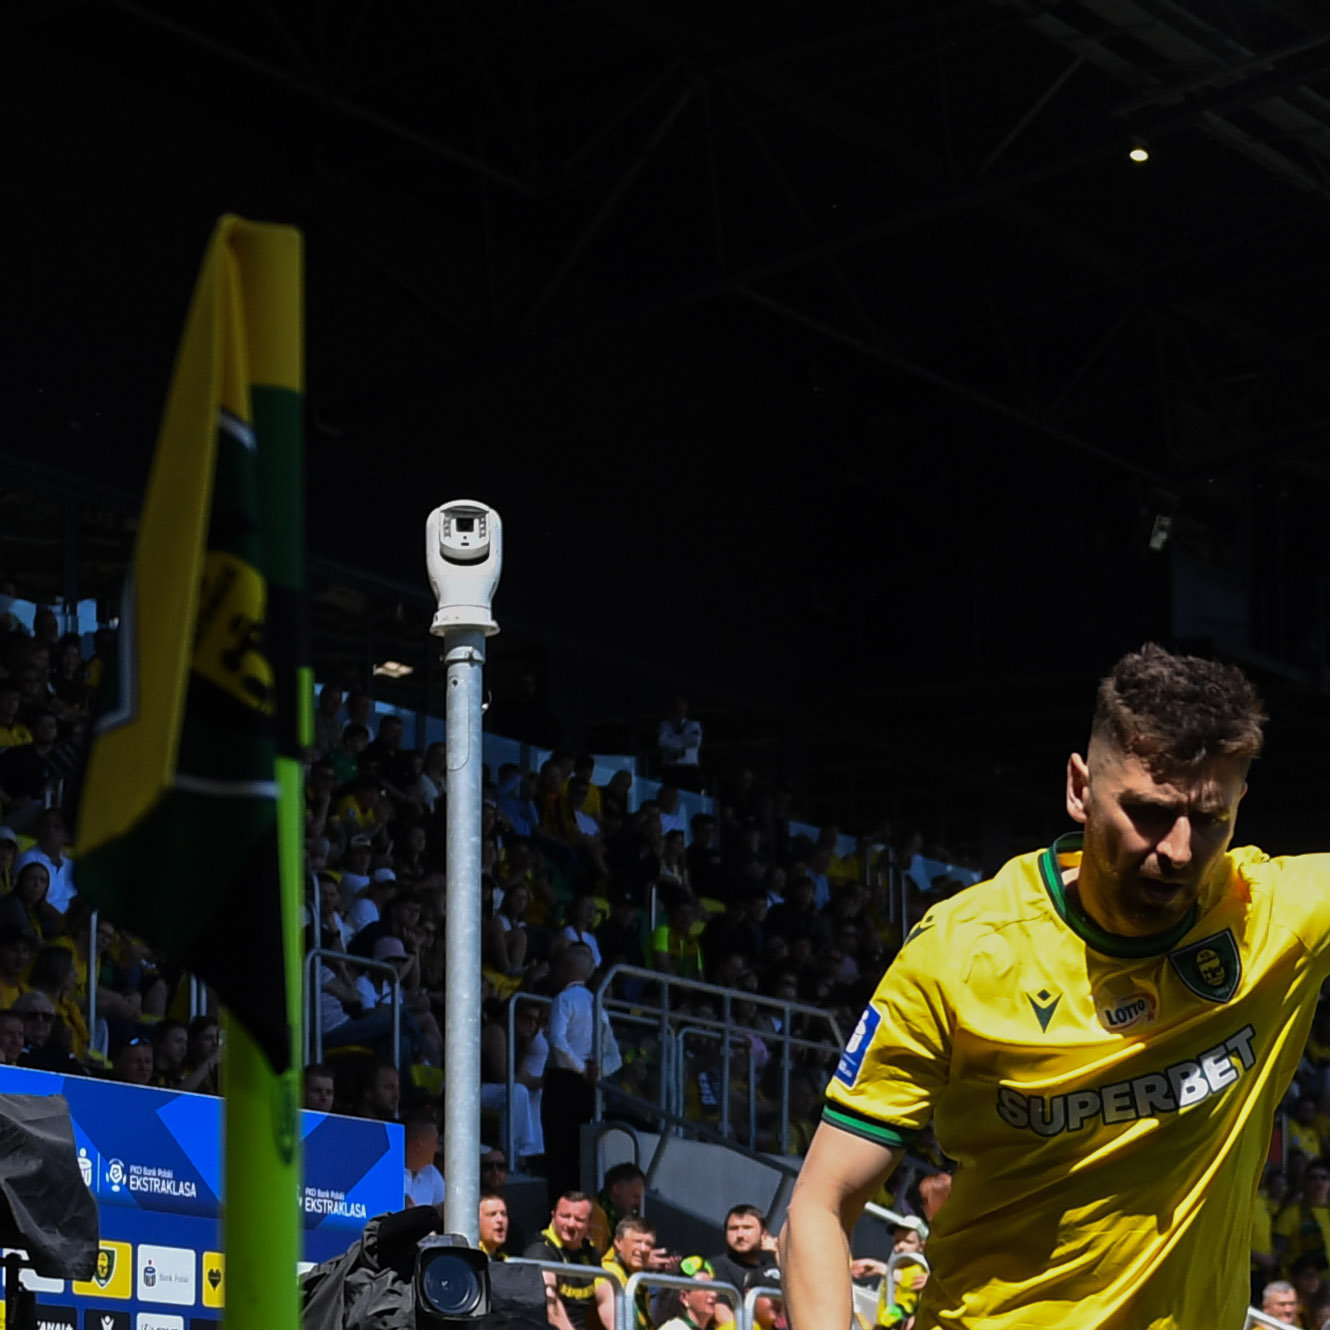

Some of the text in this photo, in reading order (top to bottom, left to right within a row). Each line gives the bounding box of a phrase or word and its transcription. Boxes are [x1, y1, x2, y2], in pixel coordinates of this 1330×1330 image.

[1104, 999, 1146, 1026] LOTTO
[996, 1024, 1257, 1137] SUPERBET
[129, 1175, 197, 1199] EKSTRAKLASA
[304, 1196, 367, 1219] EKSTRAKLASA
